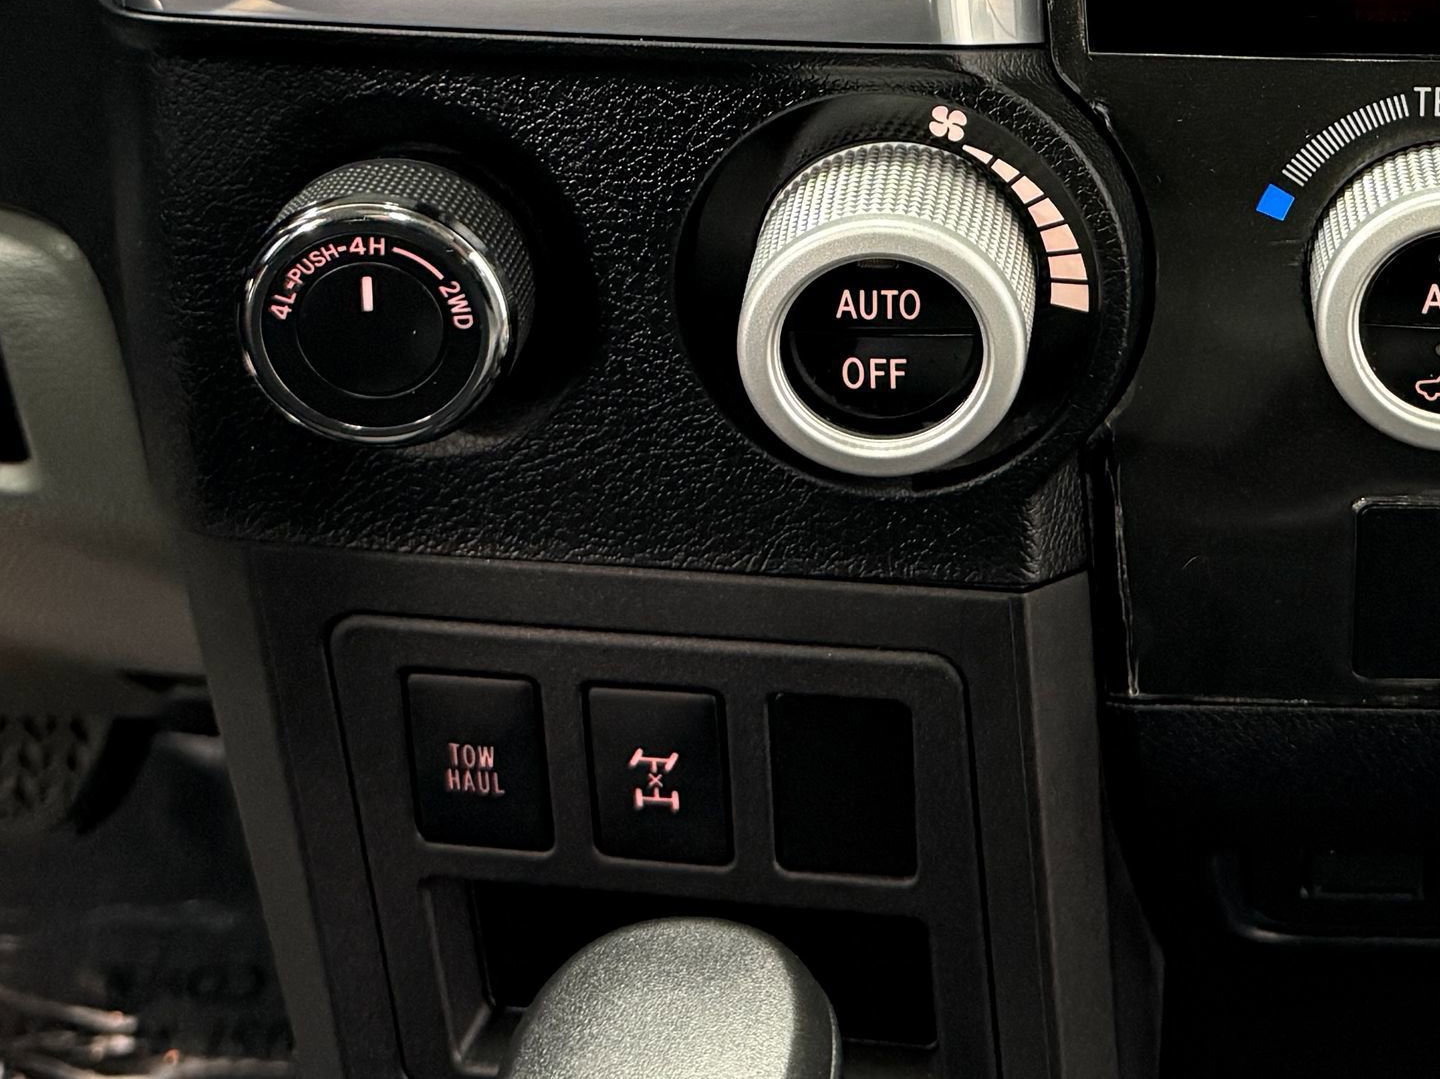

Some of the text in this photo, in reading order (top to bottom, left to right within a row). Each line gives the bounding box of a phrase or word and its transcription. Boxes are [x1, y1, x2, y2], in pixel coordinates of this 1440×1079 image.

[438, 280, 474, 330] 2WD
[835, 289, 921, 321] AUTO
[842, 357, 907, 390] OFF
[448, 742, 495, 769] TOW
[446, 769, 505, 795] HAUL
